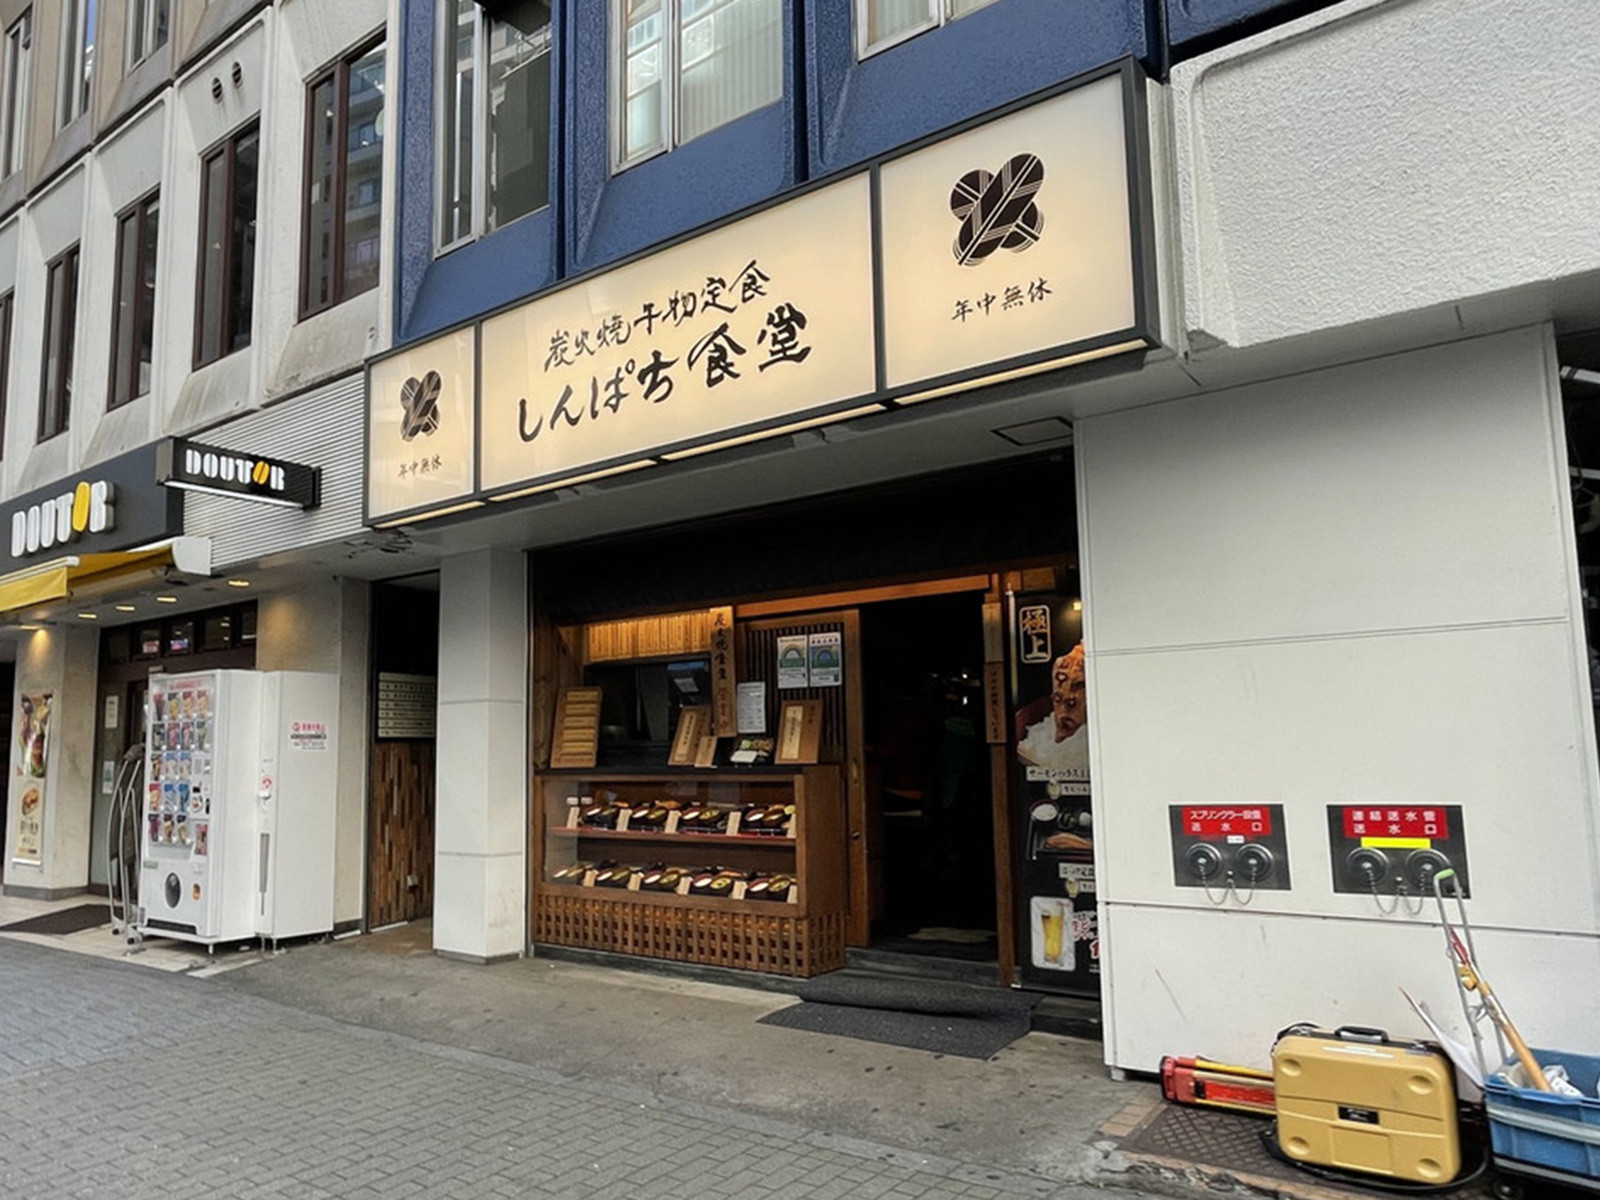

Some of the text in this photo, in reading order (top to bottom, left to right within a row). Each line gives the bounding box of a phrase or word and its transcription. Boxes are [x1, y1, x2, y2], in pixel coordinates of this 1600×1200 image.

[545, 260, 770, 372] 炭火焼干物定食
[951, 277, 1053, 322] 年中無休
[518, 302, 812, 443] しんぱち食堂
[185, 449, 286, 491] DOUTOR
[398, 453, 442, 479] 年中無休
[11, 480, 109, 558] DOUTOR
[1191, 821, 1263, 832] 送水口
[1353, 822, 1438, 835] 送水口
